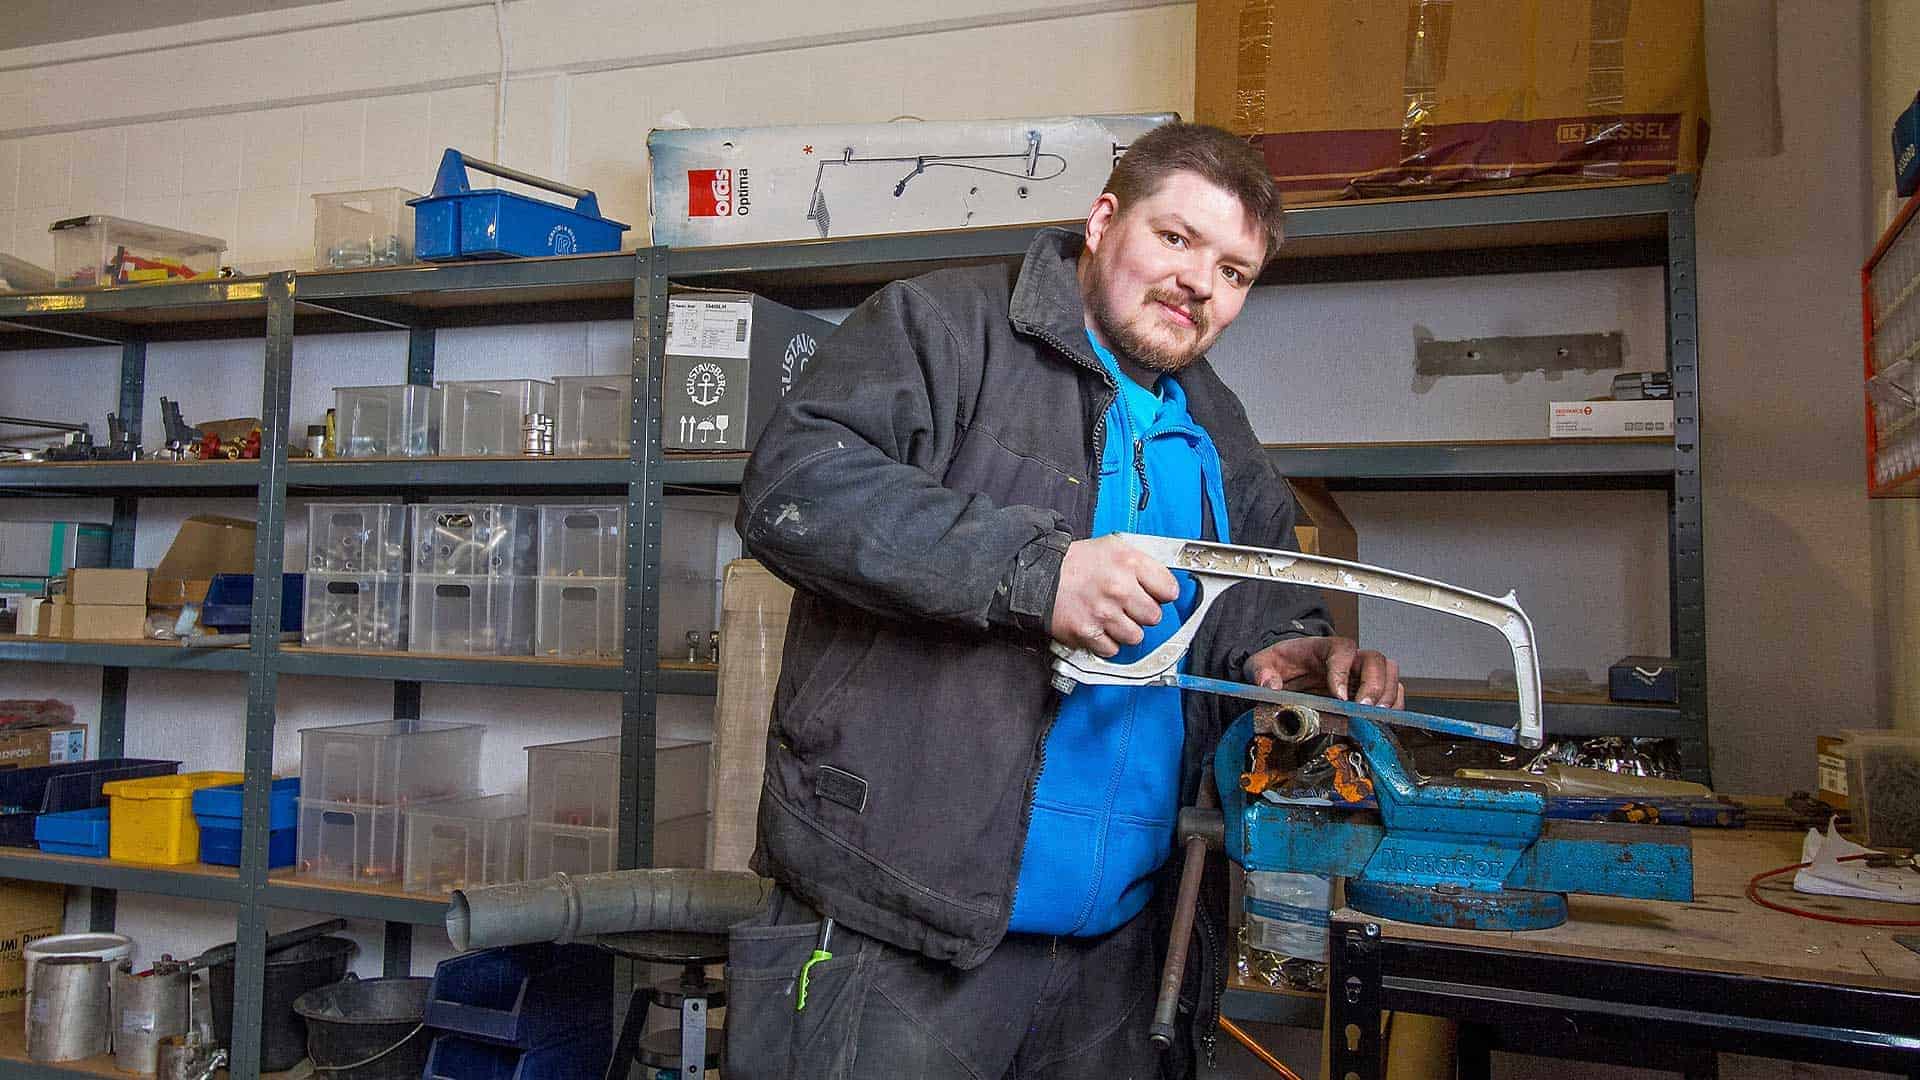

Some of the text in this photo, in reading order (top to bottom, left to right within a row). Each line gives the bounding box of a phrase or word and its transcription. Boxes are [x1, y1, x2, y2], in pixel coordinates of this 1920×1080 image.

[711, 169, 730, 216] oras
[737, 168, 751, 216] Optima
[686, 363, 726, 397] GUSTAVSBERG
[1381, 848, 1504, 880] Matador
